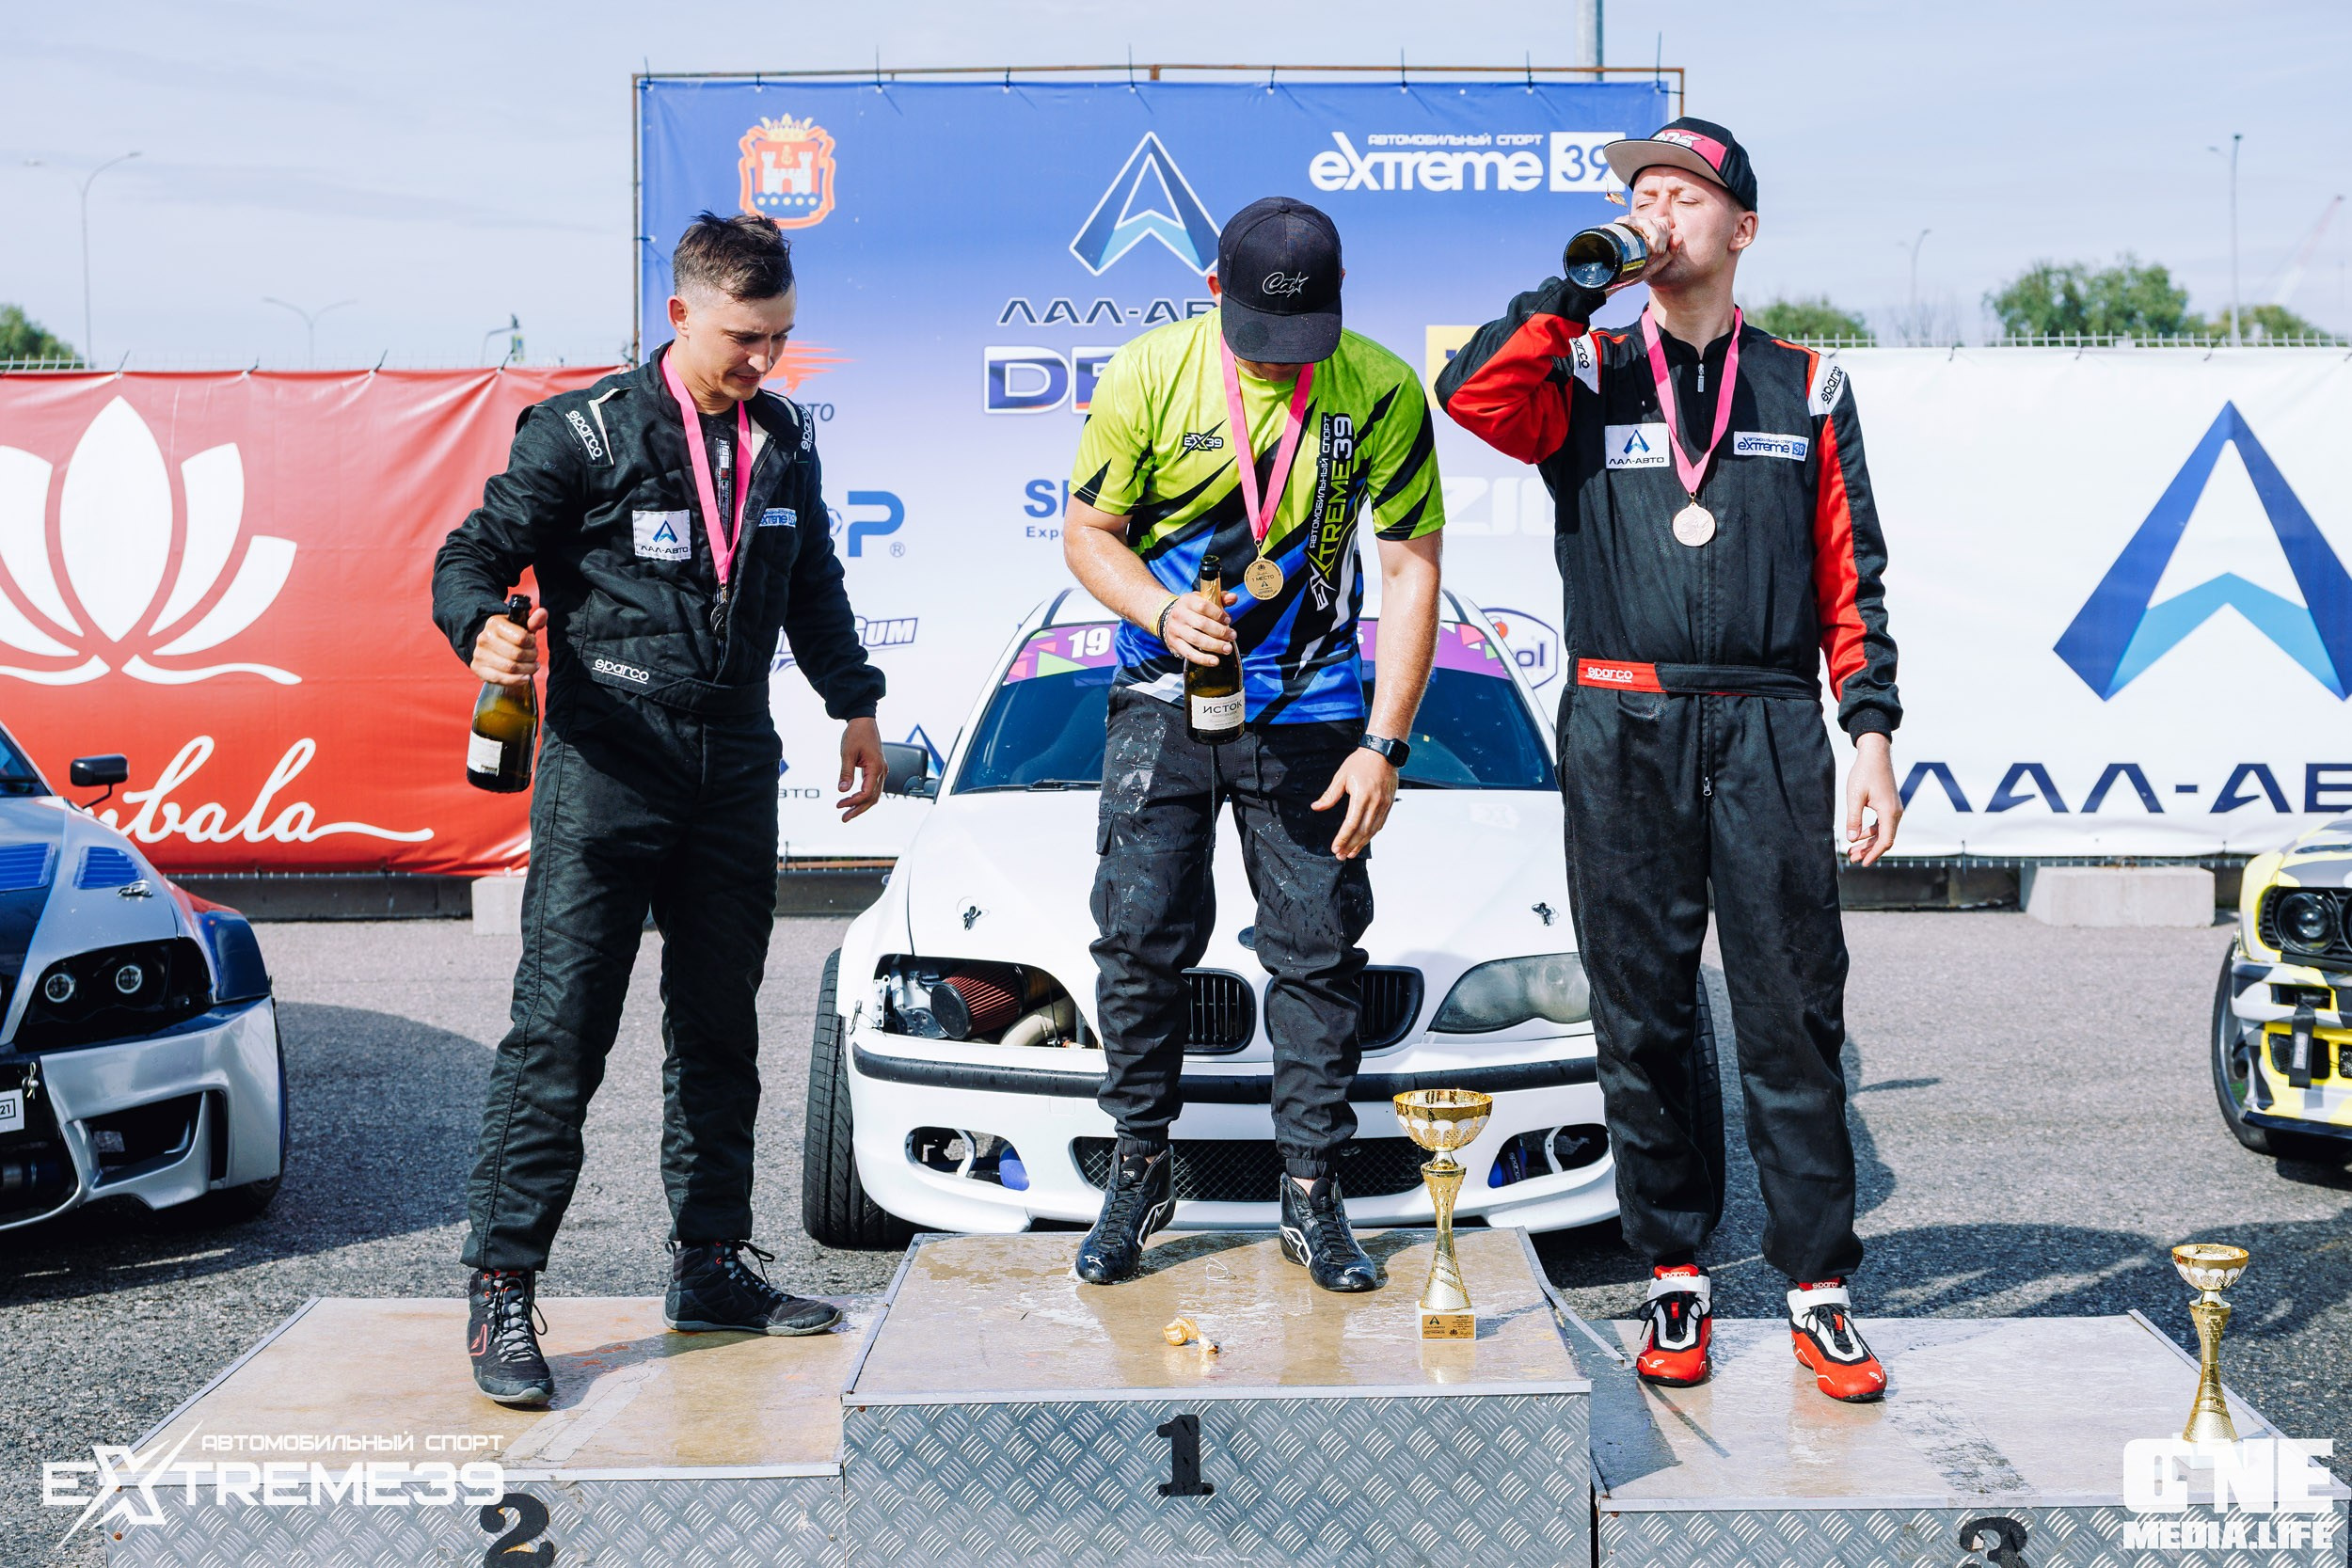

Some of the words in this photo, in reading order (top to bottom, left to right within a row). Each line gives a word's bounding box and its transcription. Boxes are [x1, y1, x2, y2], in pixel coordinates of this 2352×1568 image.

[1496, 135, 1544, 146] СПОРТ
[564, 409, 604, 460] sparco
[1322, 415, 1331, 453] СПОРТ
[1793, 443, 1804, 454] 39
[1068, 627, 1111, 658] 19
[593, 658, 649, 684] sparco
[1586, 666, 1633, 682] sparco
[1203, 700, 1243, 713] ИСТОК
[1156, 1414, 1215, 1497] 1
[479, 1493, 555, 1568] 2
